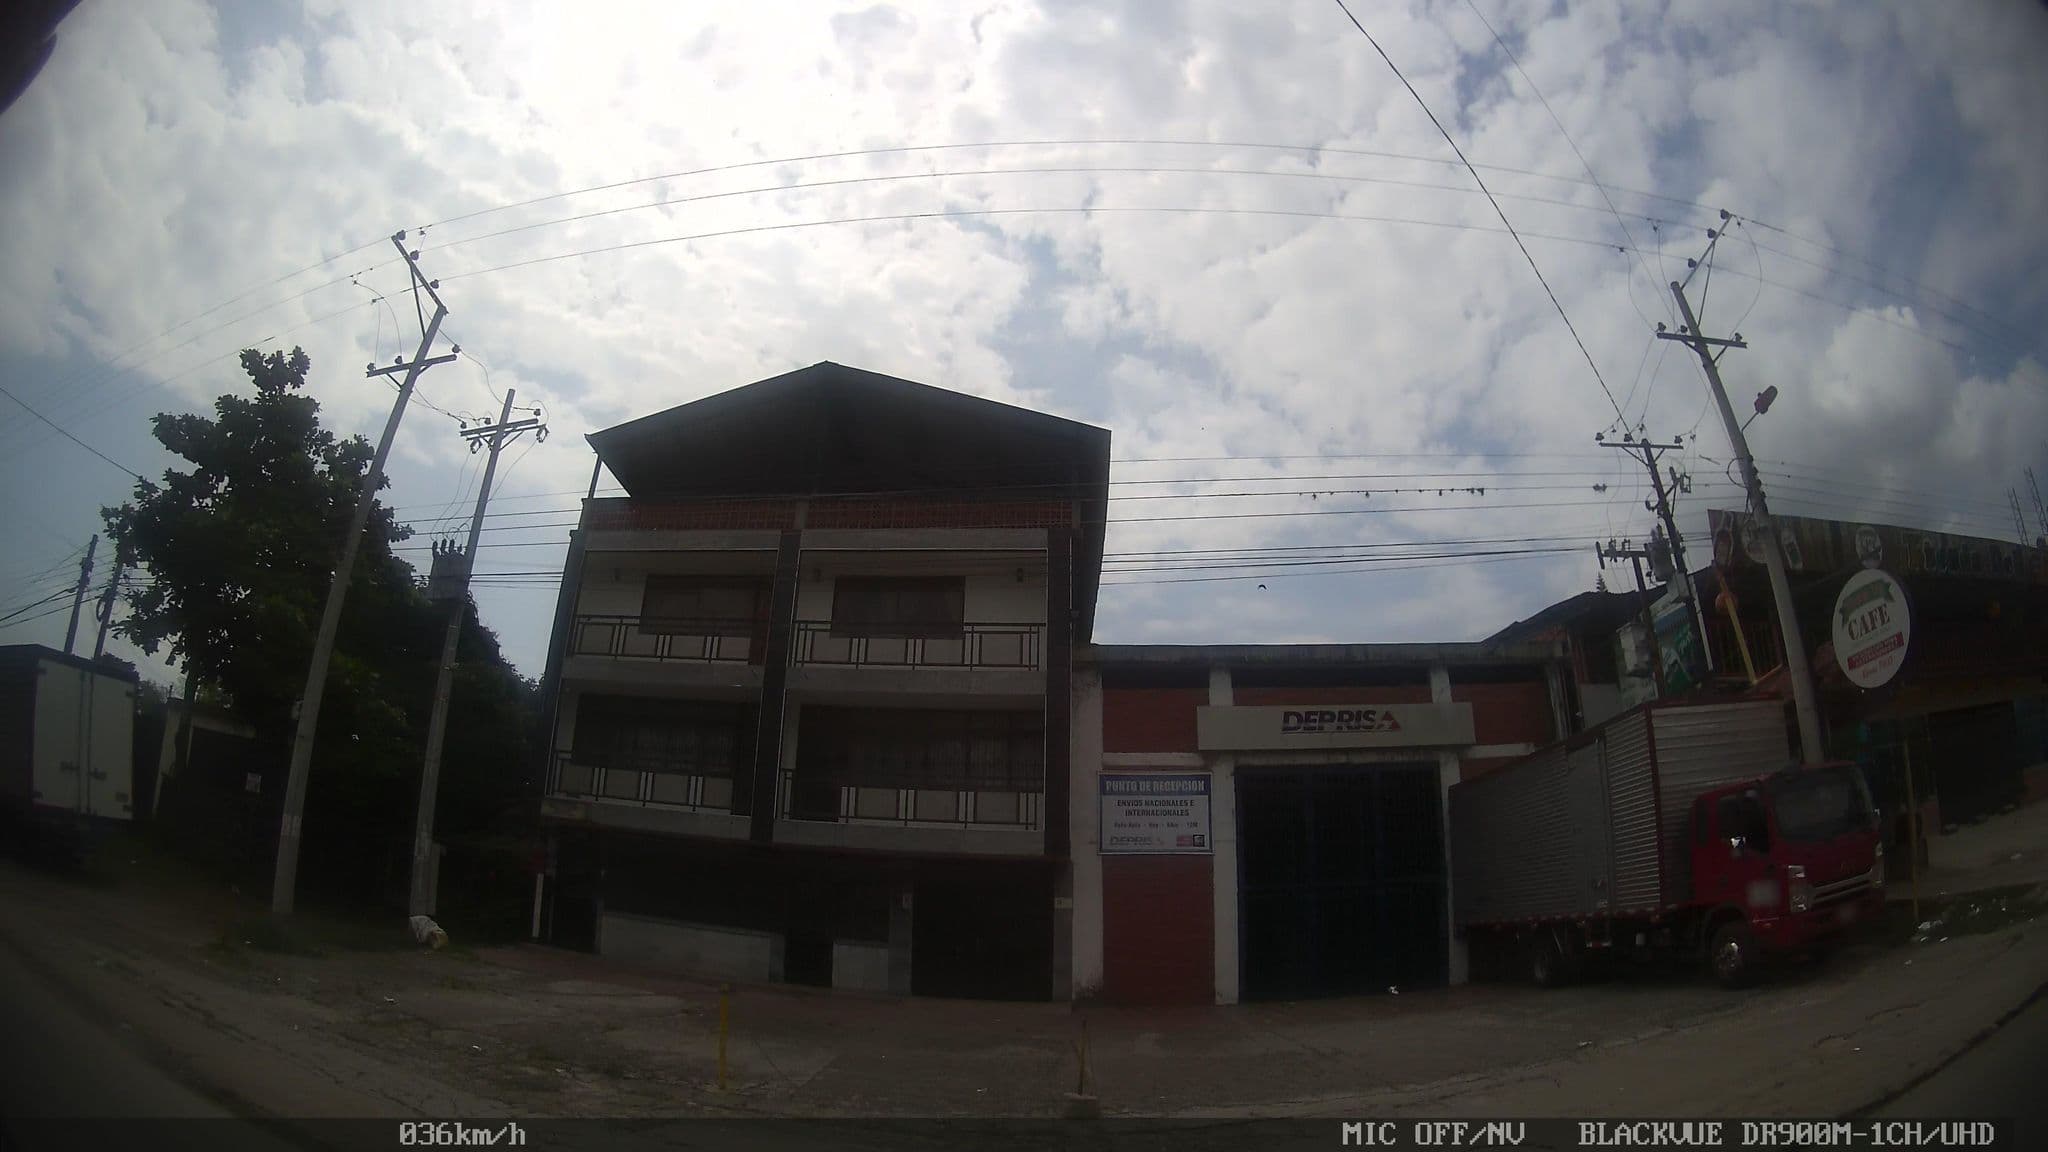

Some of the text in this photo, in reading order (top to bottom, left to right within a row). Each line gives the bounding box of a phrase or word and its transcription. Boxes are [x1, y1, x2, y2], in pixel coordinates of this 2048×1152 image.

[1281, 710, 1401, 731] DEPRISA
[1106, 780, 1137, 792] PUNTO
[1139, 780, 1152, 792] DE
[1117, 799, 1143, 807] ENVIOS
[1125, 809, 1190, 817] INTERNACIONALES
